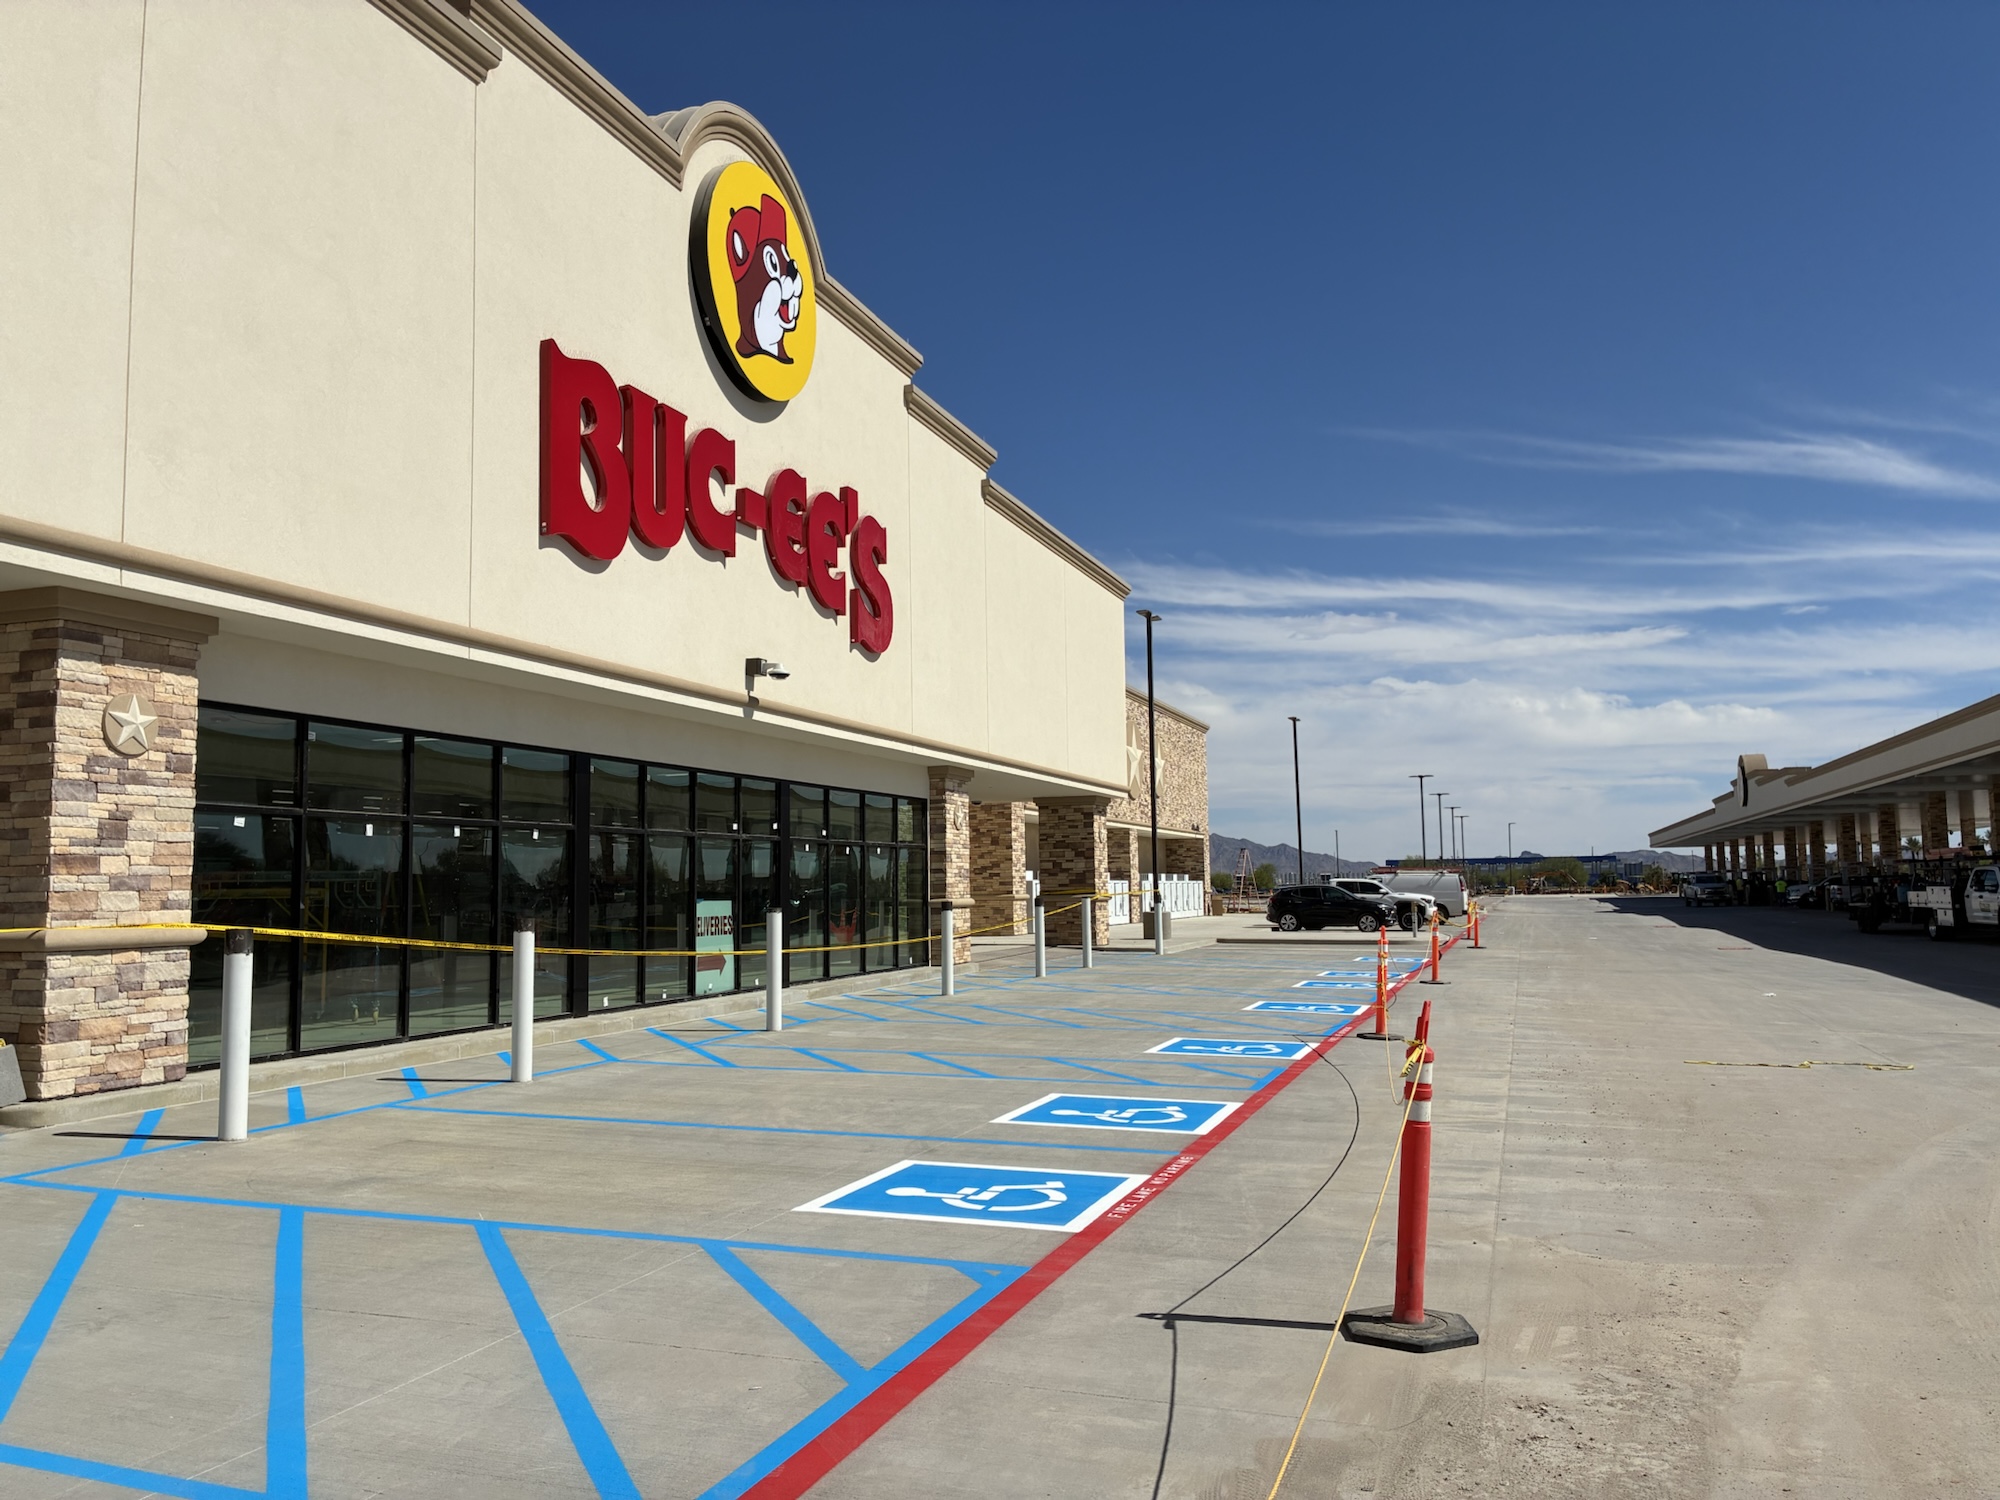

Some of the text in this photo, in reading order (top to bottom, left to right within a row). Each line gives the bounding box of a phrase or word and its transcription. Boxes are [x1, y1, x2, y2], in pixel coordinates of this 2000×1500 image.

[539, 338, 893, 653] BUC-EE'S
[696, 915, 734, 937] ELIVERIES
[1107, 1202, 1137, 1219] FIRE
[1126, 1187, 1157, 1203] LANE
[1158, 1156, 1194, 1178] PARKING
